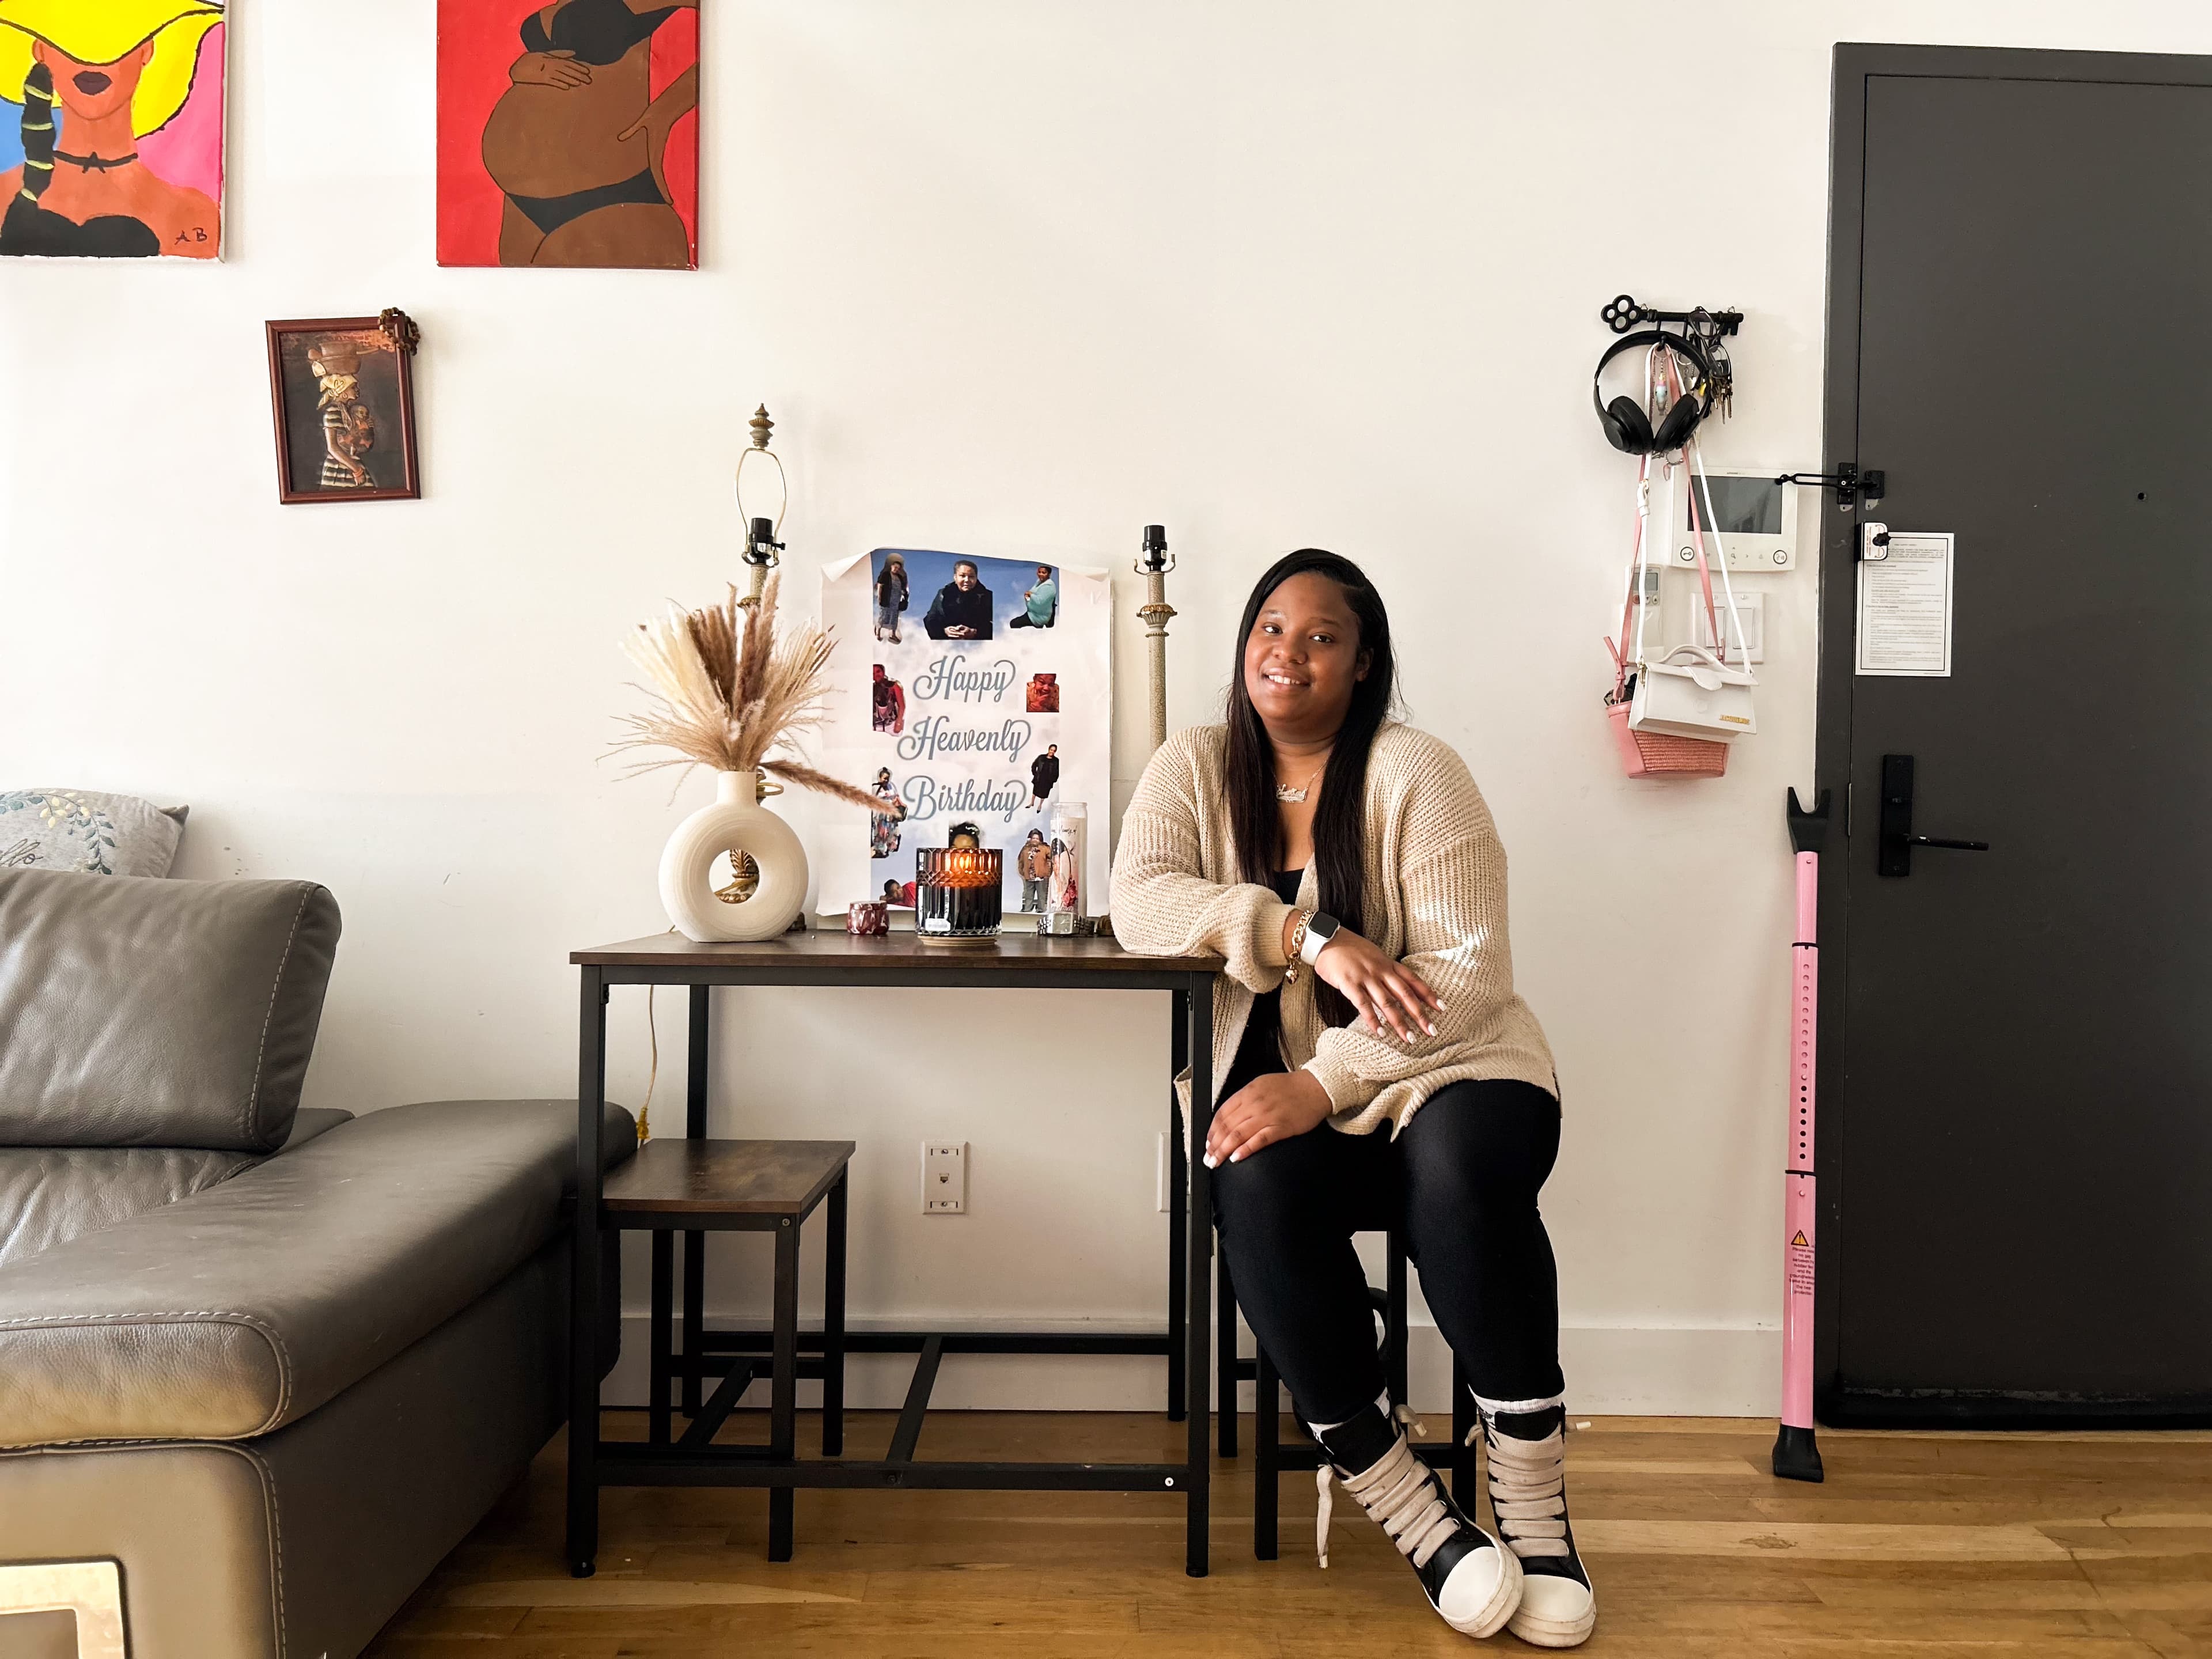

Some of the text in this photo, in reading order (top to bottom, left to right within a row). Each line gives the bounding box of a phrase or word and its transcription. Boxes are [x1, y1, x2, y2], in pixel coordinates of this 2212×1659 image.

[175, 227, 207, 245] A B
[913, 655, 1016, 703] Happy
[897, 715, 1031, 763] Heavenly
[903, 775, 1027, 823] Birthday
